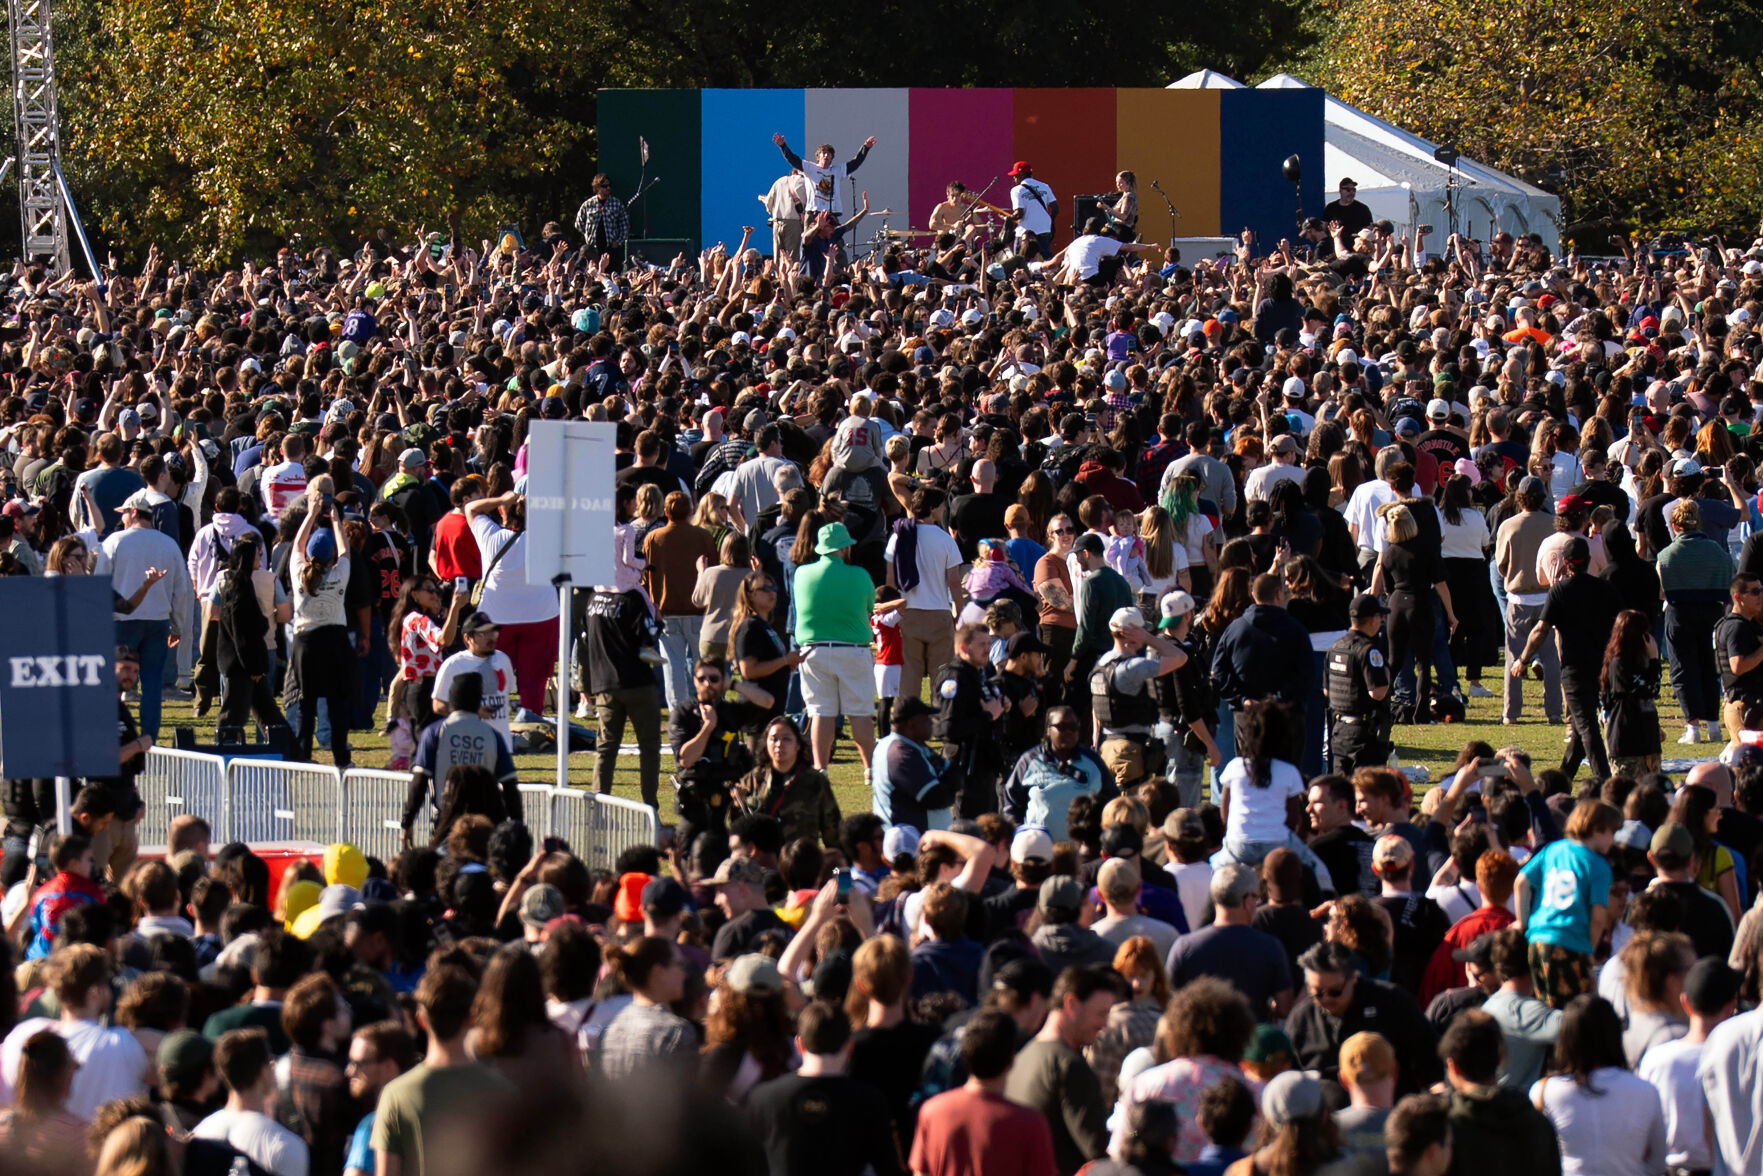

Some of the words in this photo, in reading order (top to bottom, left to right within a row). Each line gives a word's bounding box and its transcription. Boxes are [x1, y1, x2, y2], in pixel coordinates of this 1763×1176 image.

[346, 318, 358, 336] 8
[847, 427, 868, 446] 15
[10, 655, 105, 687] EXIT
[450, 734, 485, 750] CSC
[450, 750, 484, 764] EVENT
